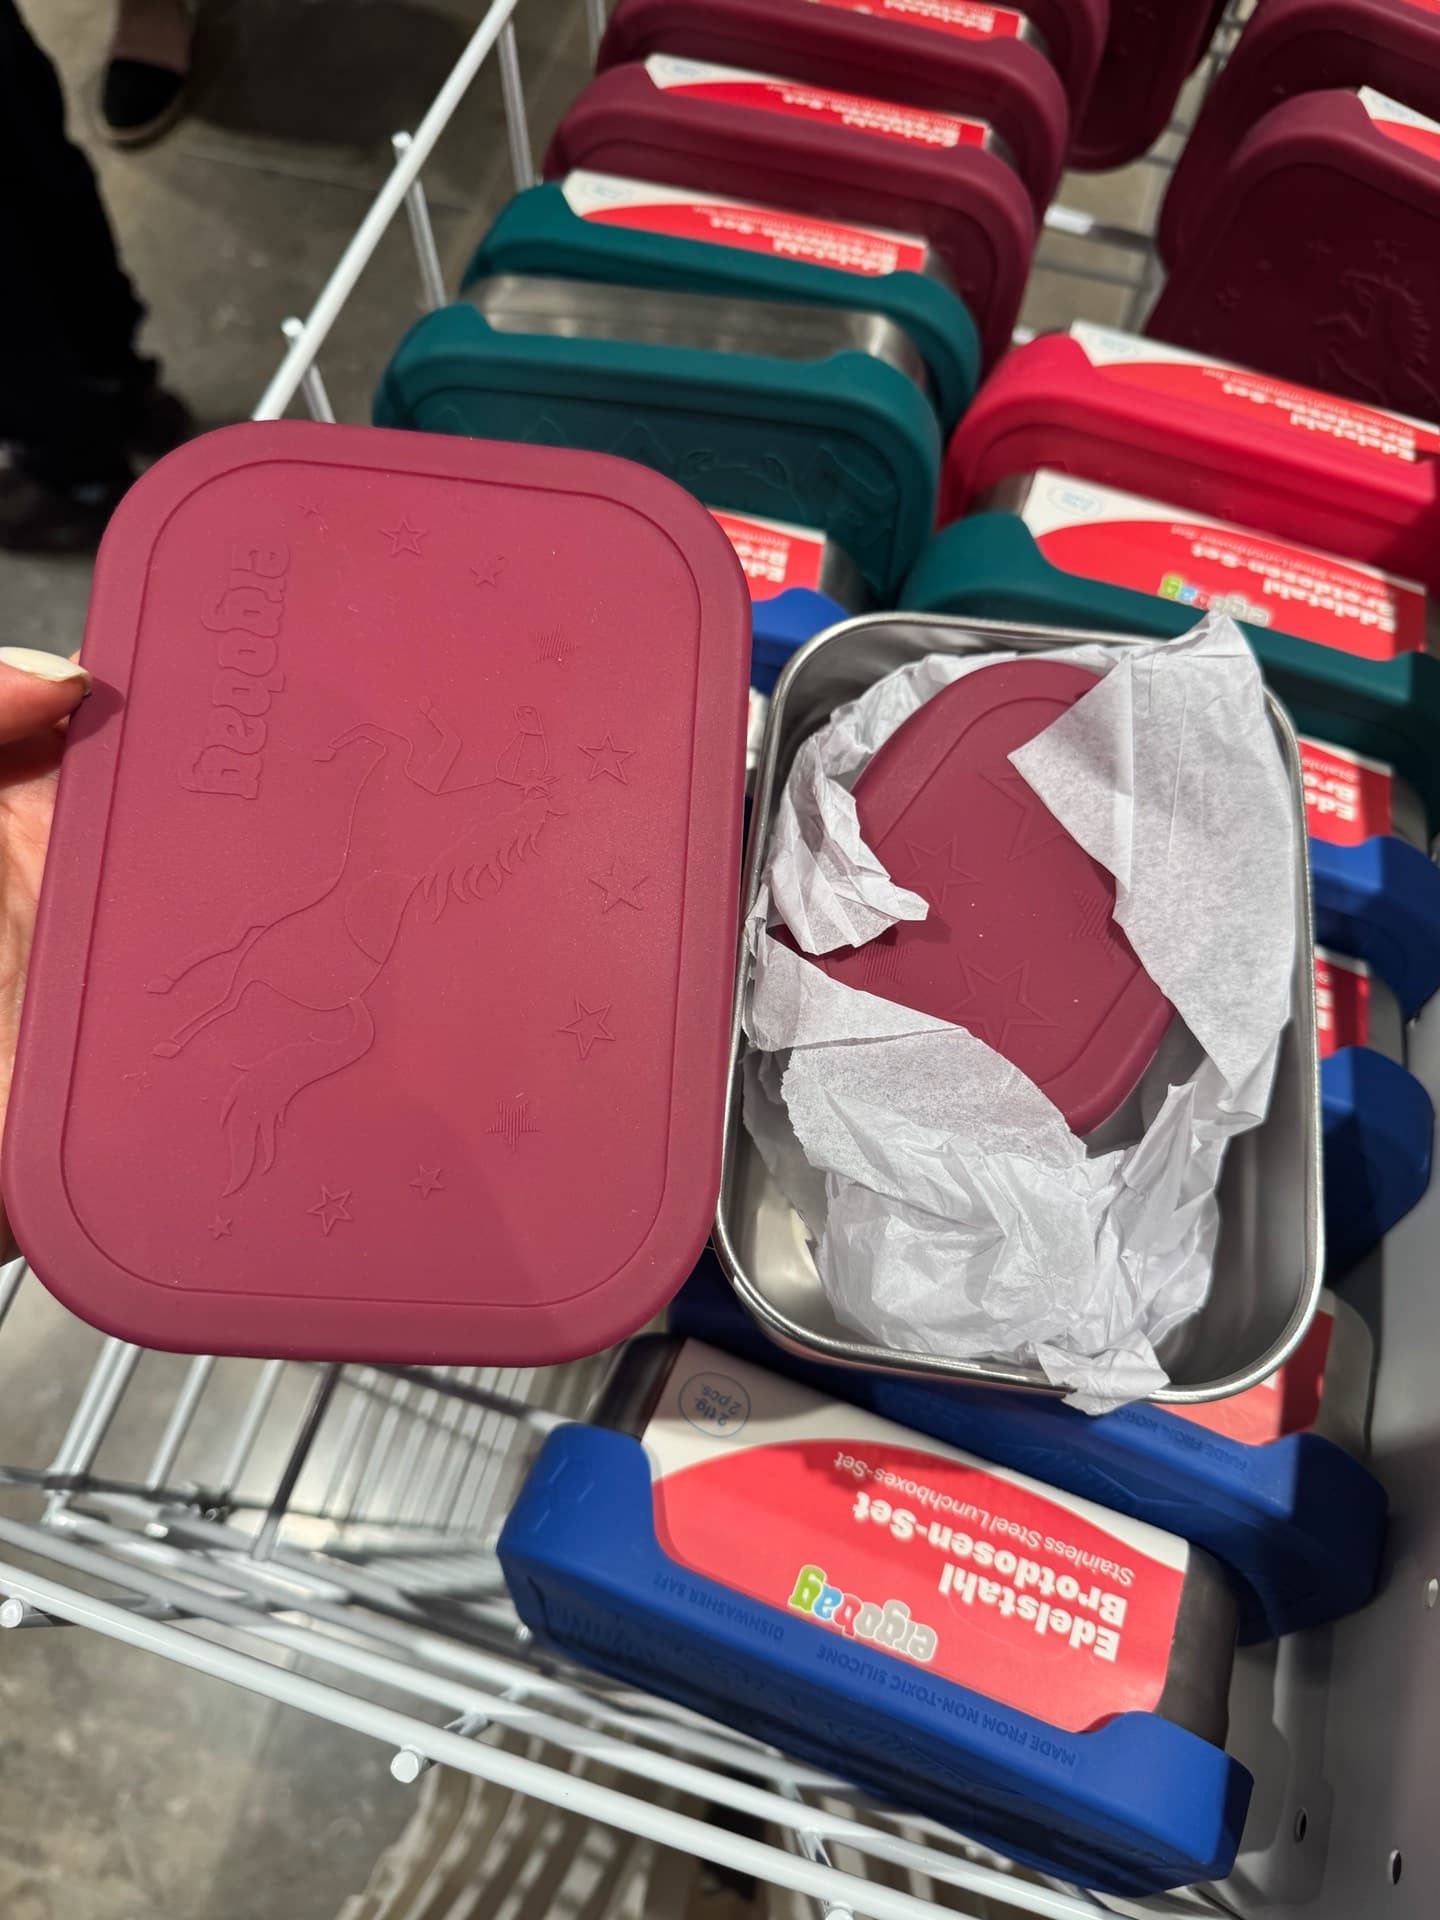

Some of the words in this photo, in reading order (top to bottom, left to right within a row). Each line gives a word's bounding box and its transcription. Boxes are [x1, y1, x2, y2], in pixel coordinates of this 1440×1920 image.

[834, 1451, 990, 1529] Lunchboxes-Set
[989, 1515, 1042, 1549] Steel
[852, 1491, 1128, 1629] Brotdosen-Set
[1043, 1536, 1136, 1589] Stainless
[787, 1564, 939, 1663] ergobag
[938, 1562, 1121, 1663] Edelstahl
[815, 1644, 891, 1685] SILICONE
[889, 1674, 980, 1726] NON-TOXIC
[982, 1714, 1029, 1746] FROM
[1031, 1733, 1077, 1767] MADE
